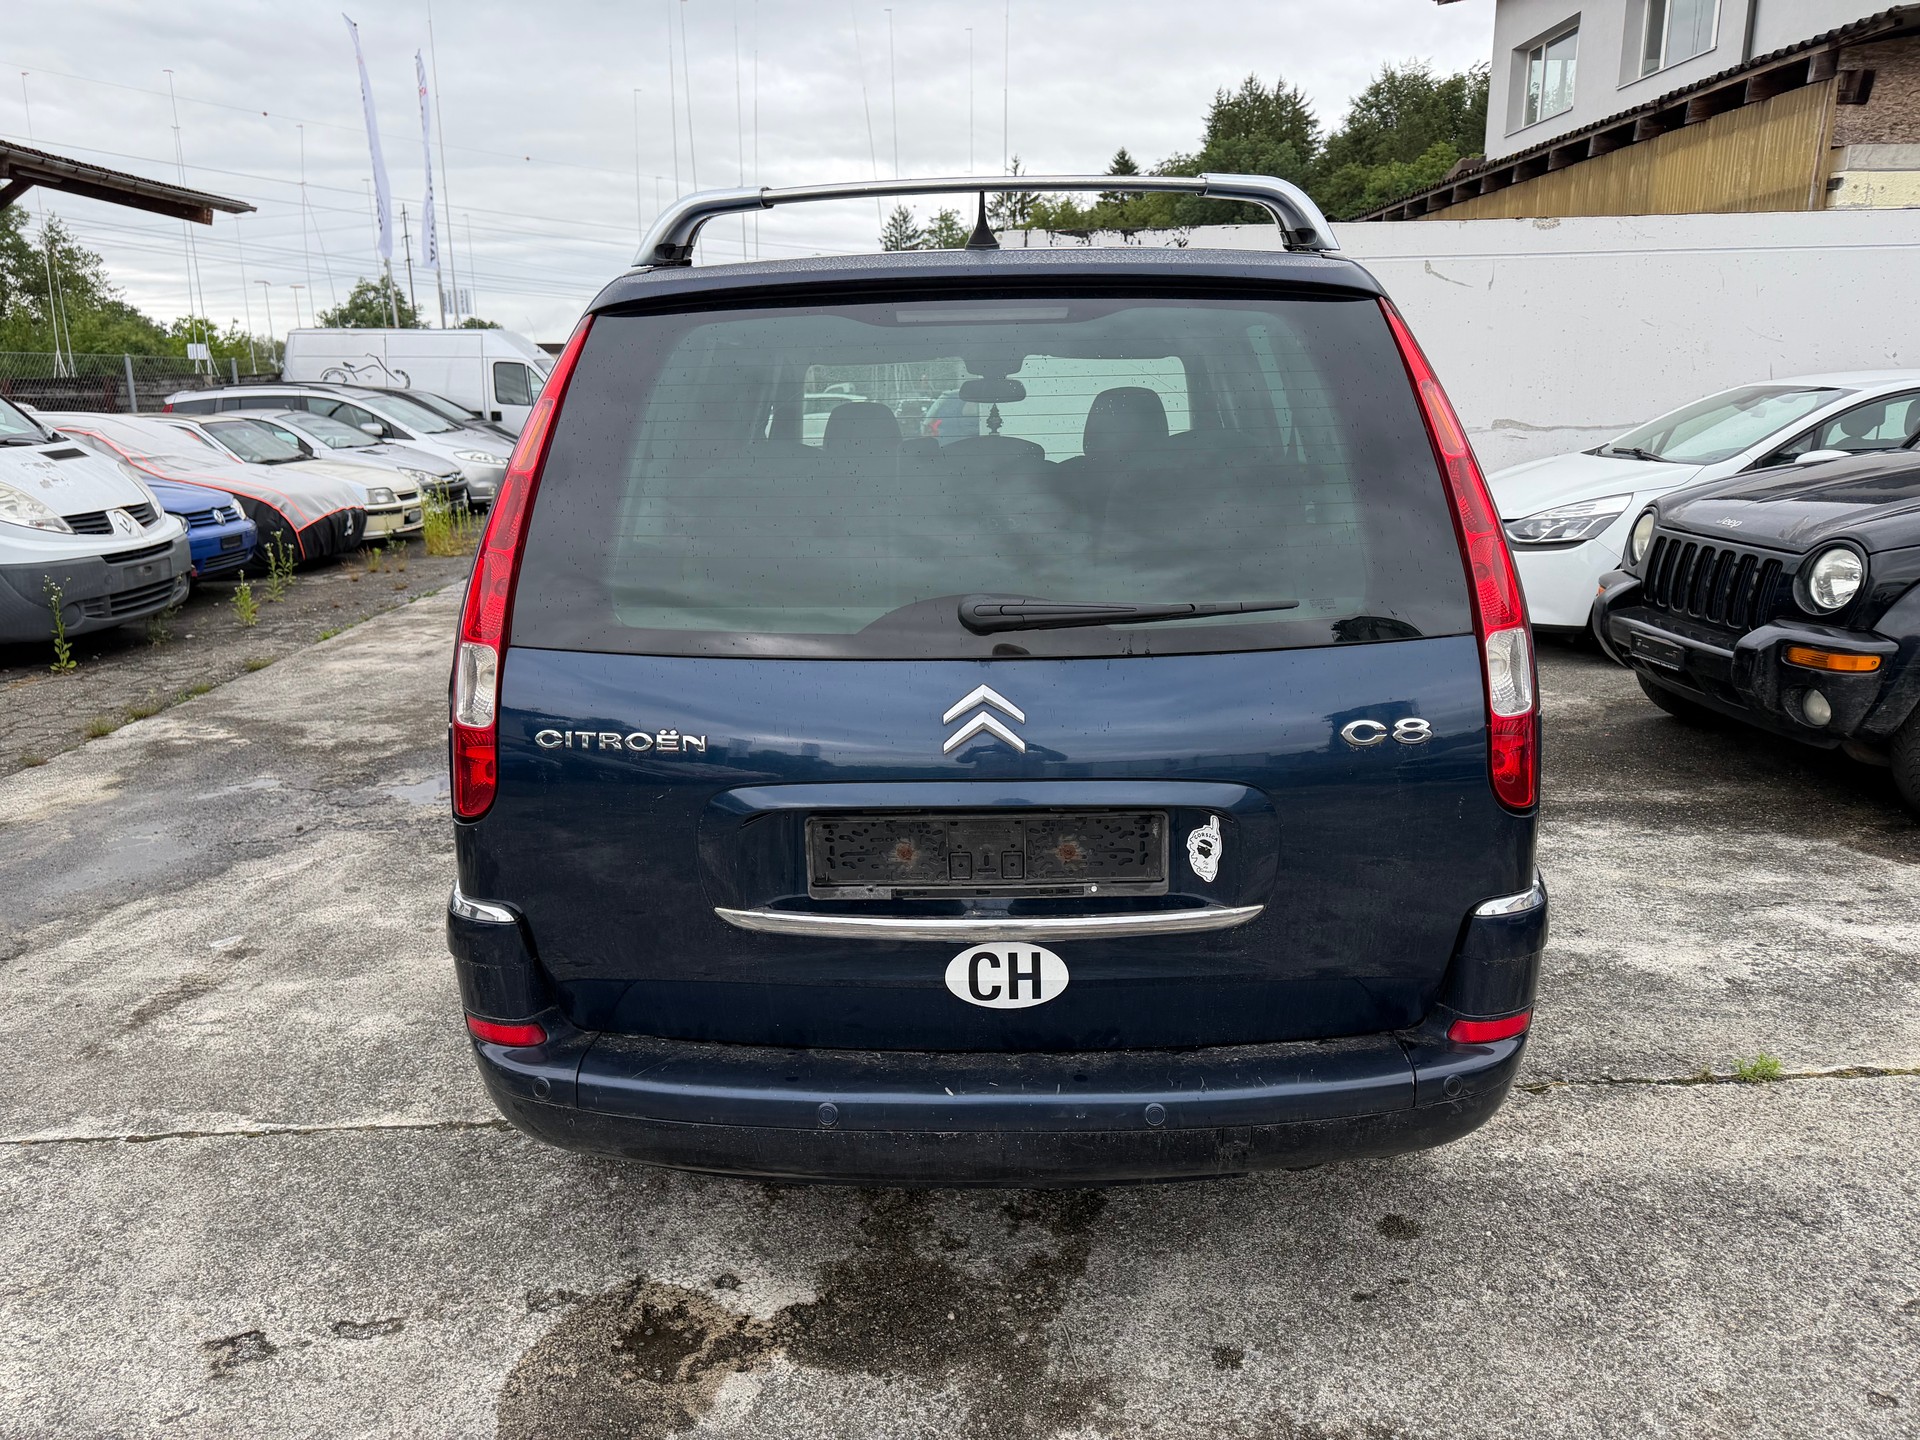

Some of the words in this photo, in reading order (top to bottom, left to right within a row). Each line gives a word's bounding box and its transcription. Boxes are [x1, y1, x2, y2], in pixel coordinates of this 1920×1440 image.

[1716, 516, 1743, 528] Jeep
[534, 728, 707, 753] CITROËN
[1340, 716, 1434, 746] C8
[967, 951, 1042, 1002] CH
